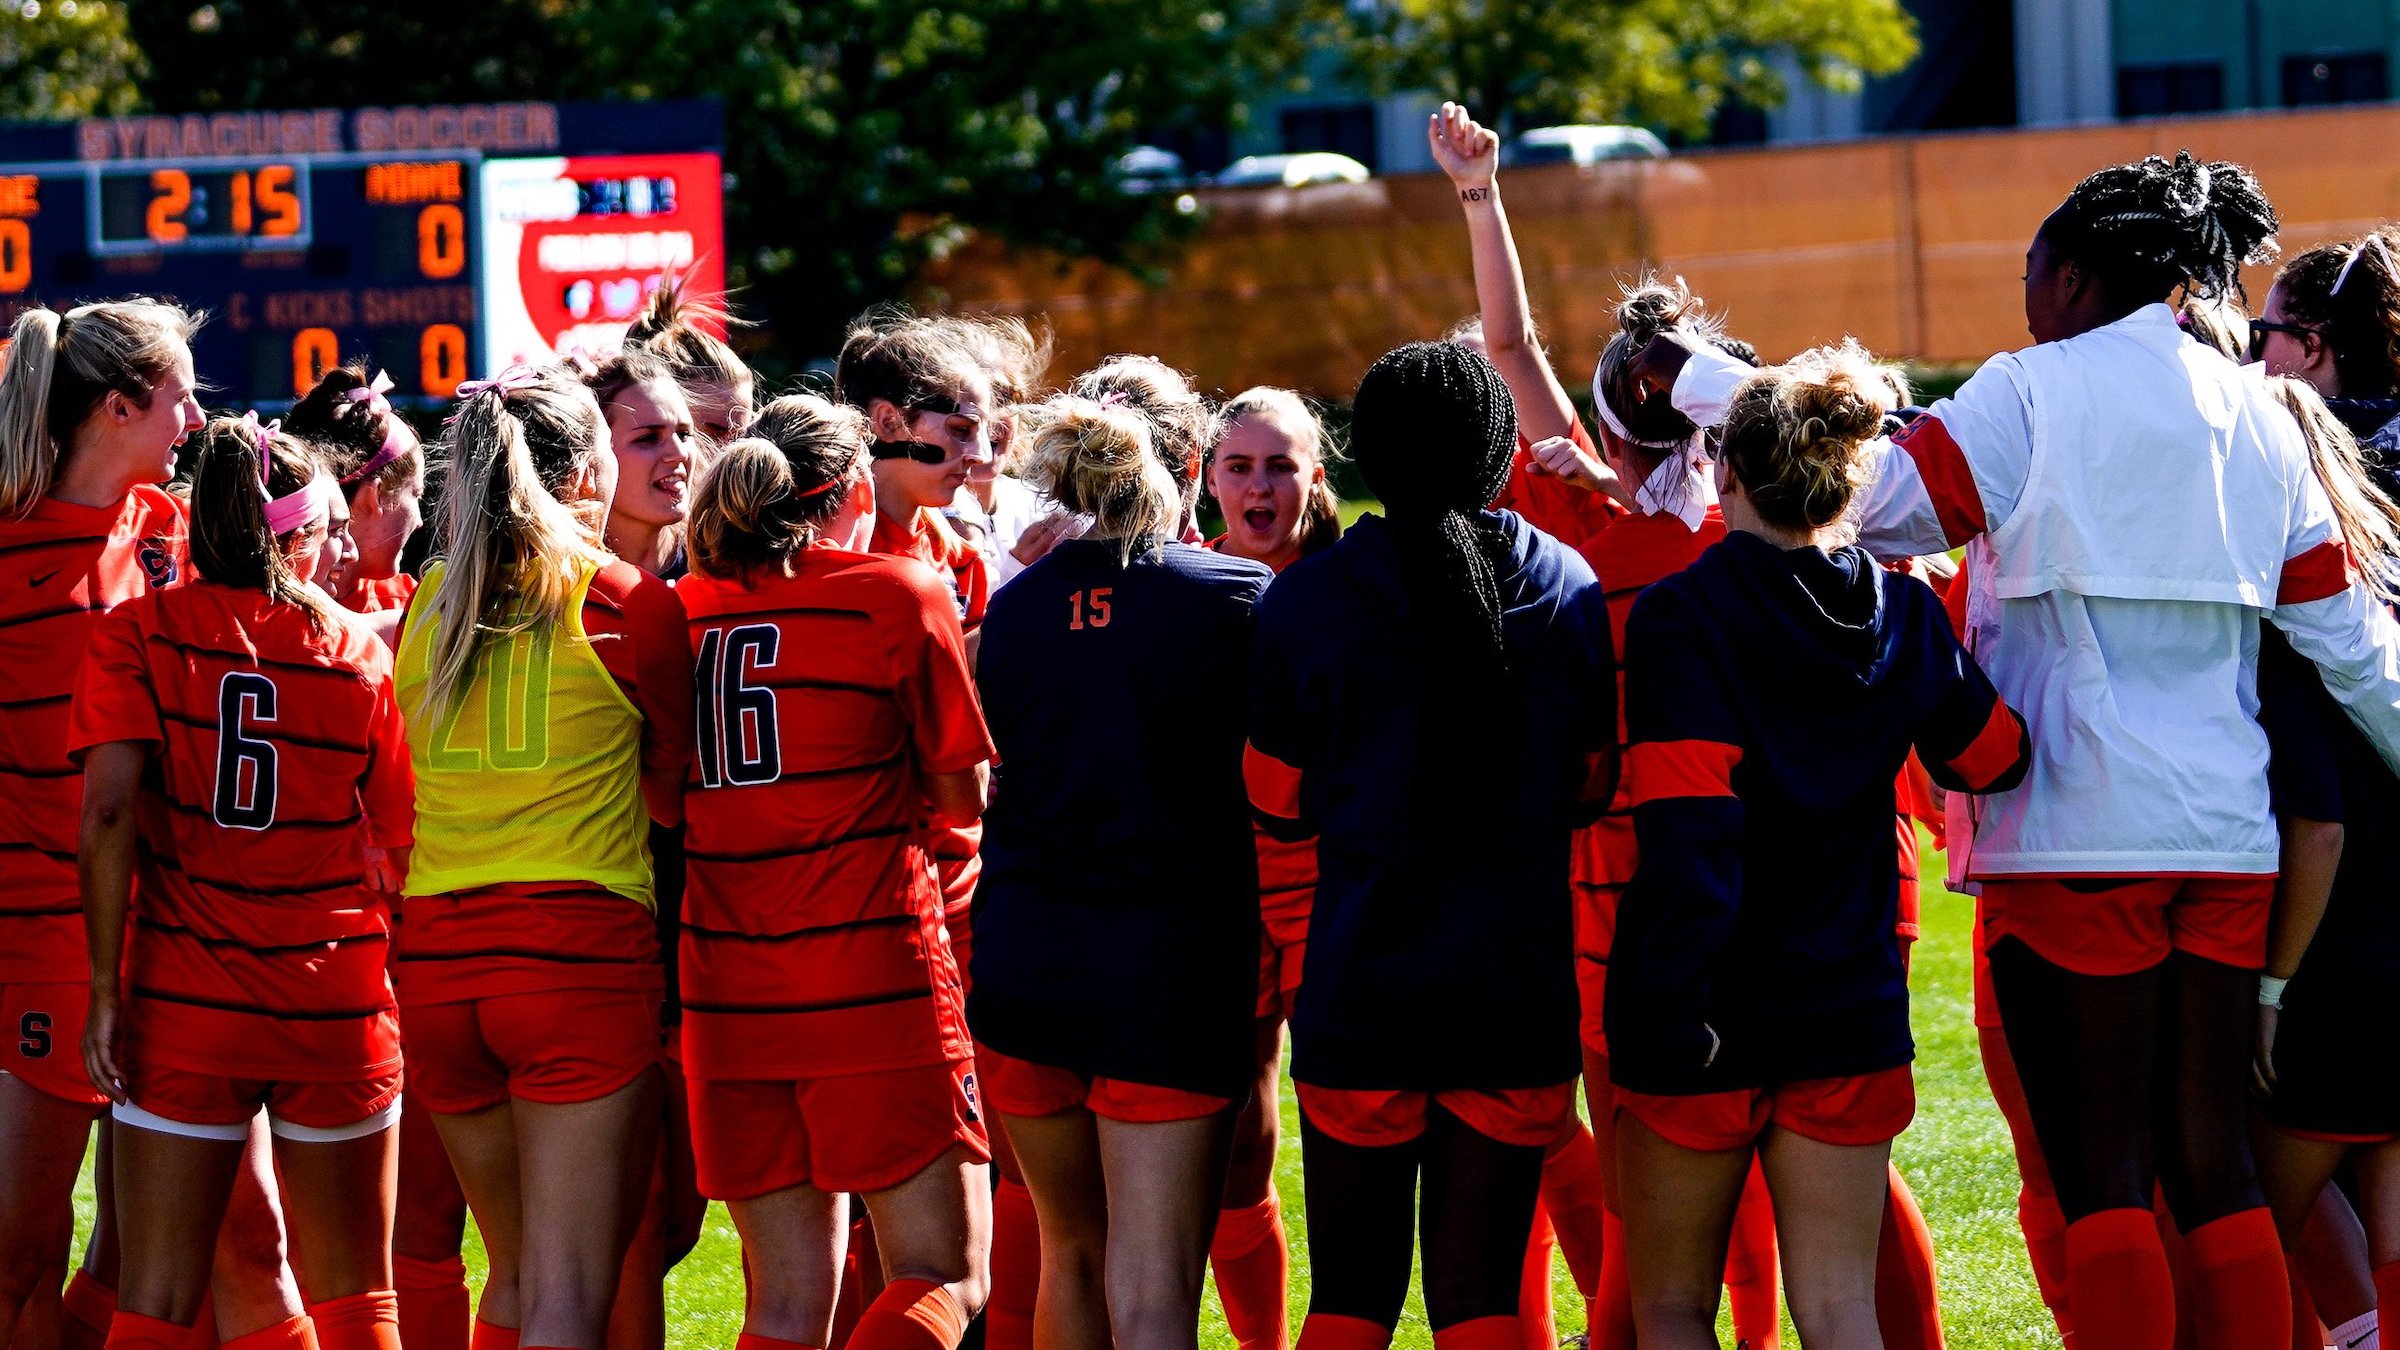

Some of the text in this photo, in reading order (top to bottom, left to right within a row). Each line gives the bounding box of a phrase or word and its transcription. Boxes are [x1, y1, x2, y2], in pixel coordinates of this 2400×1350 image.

[78, 104, 559, 160] SYRACUSE SOCCER
[1461, 187, 1488, 202] AB7
[418, 204, 465, 279] 0
[361, 284, 475, 326] SHOTS
[421, 323, 467, 398] 0
[1069, 587, 1113, 630] 15
[425, 612, 557, 773] 20
[694, 622, 782, 788] 16
[213, 671, 278, 831] 6
[19, 1010, 53, 1058] S
